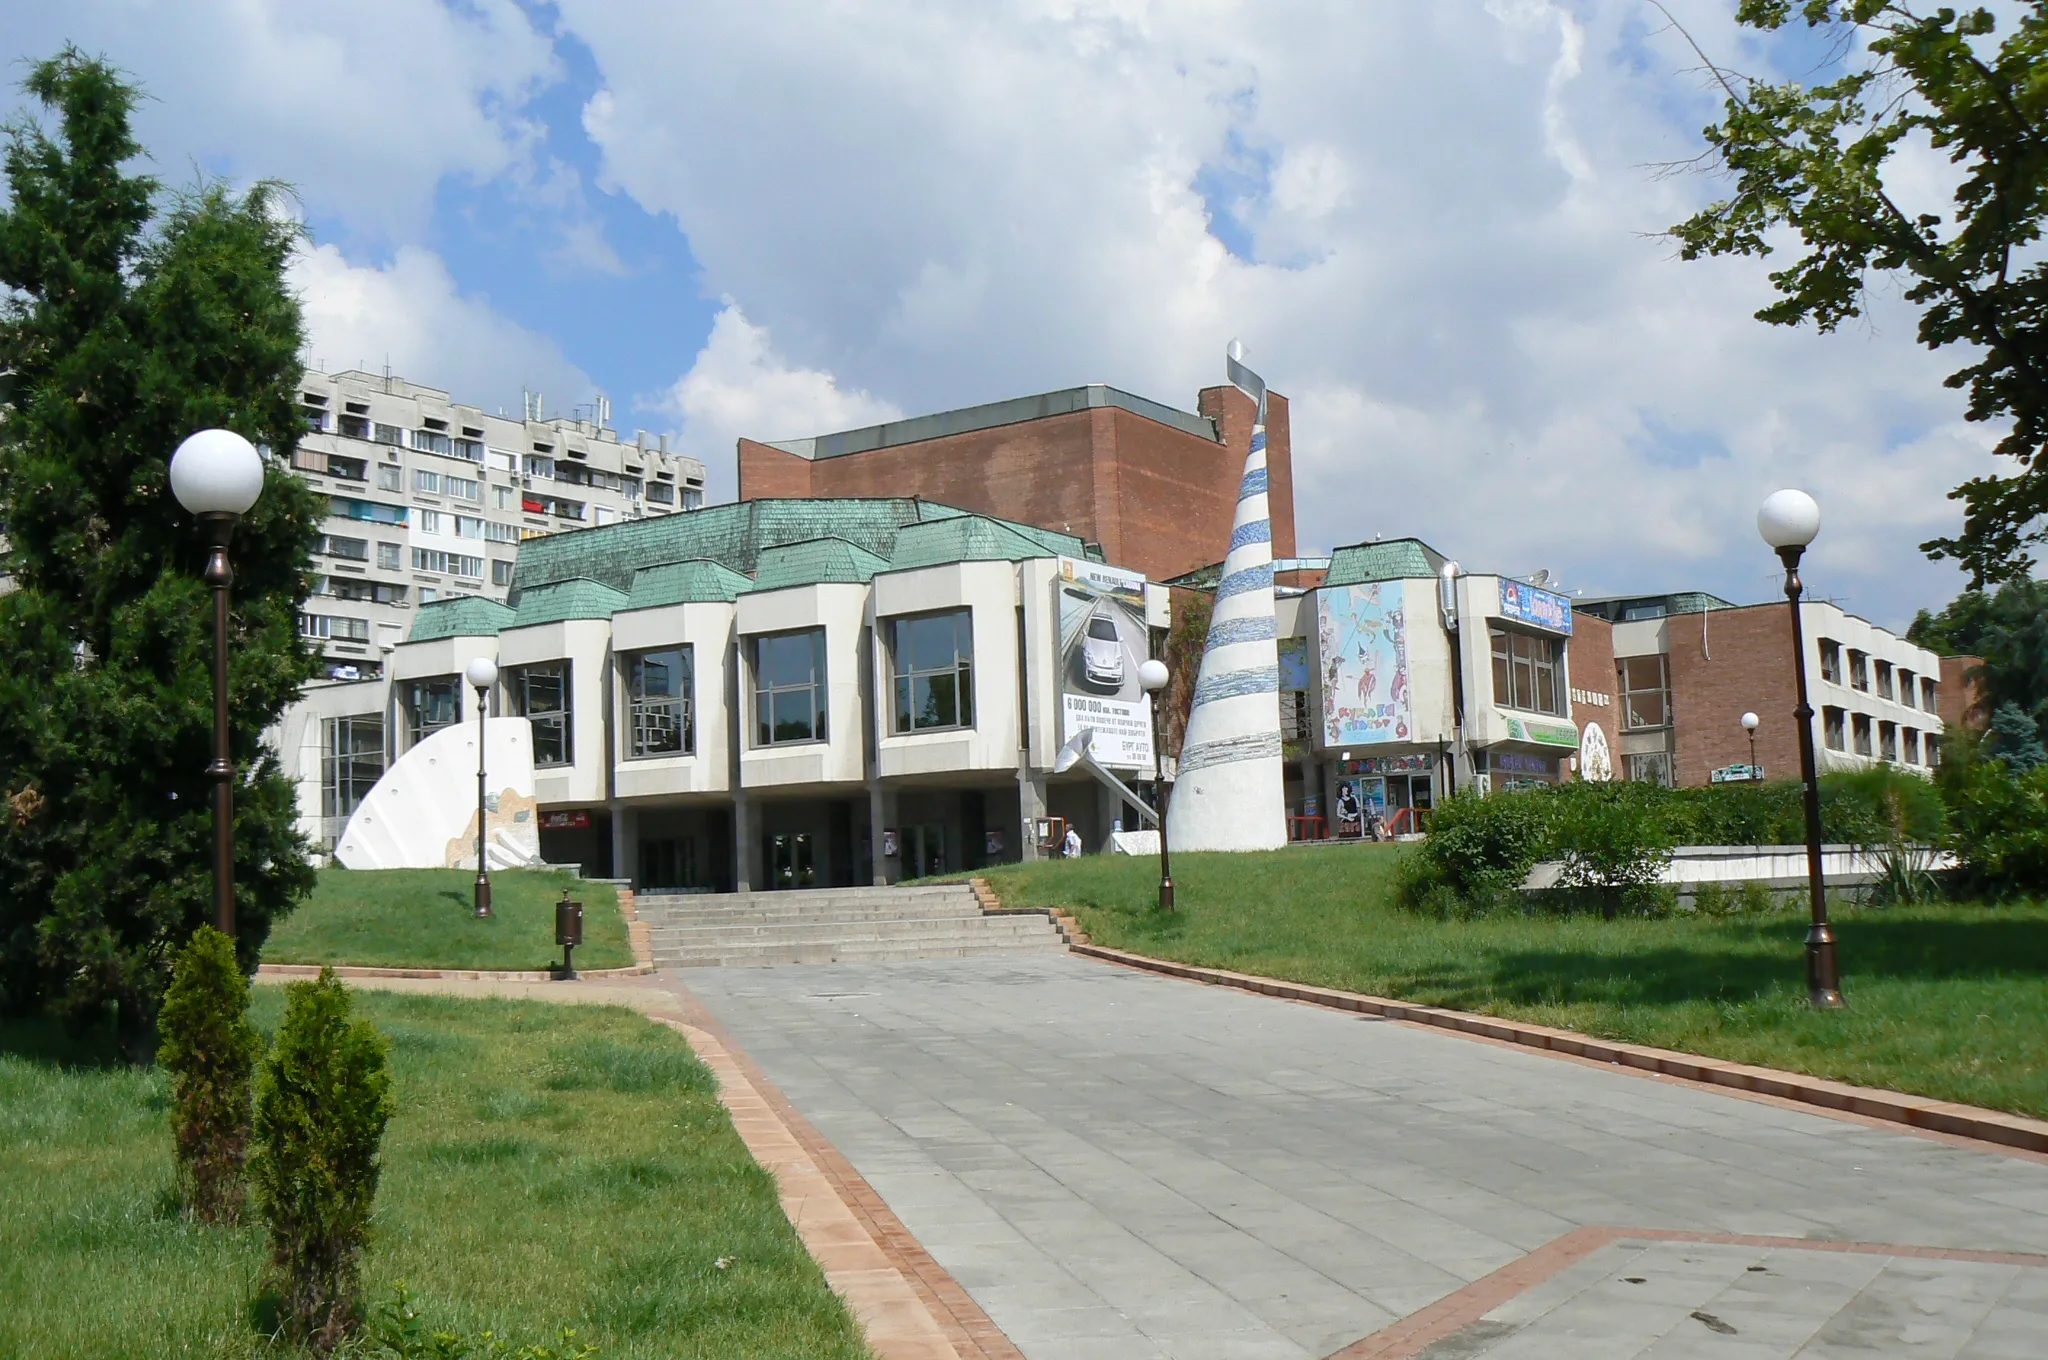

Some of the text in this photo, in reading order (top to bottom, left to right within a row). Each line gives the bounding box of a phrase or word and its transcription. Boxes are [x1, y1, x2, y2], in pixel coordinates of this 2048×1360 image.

[1067, 697, 1072, 709] 6
[1073, 698, 1087, 712] 000
[1088, 700, 1102, 713] 000
